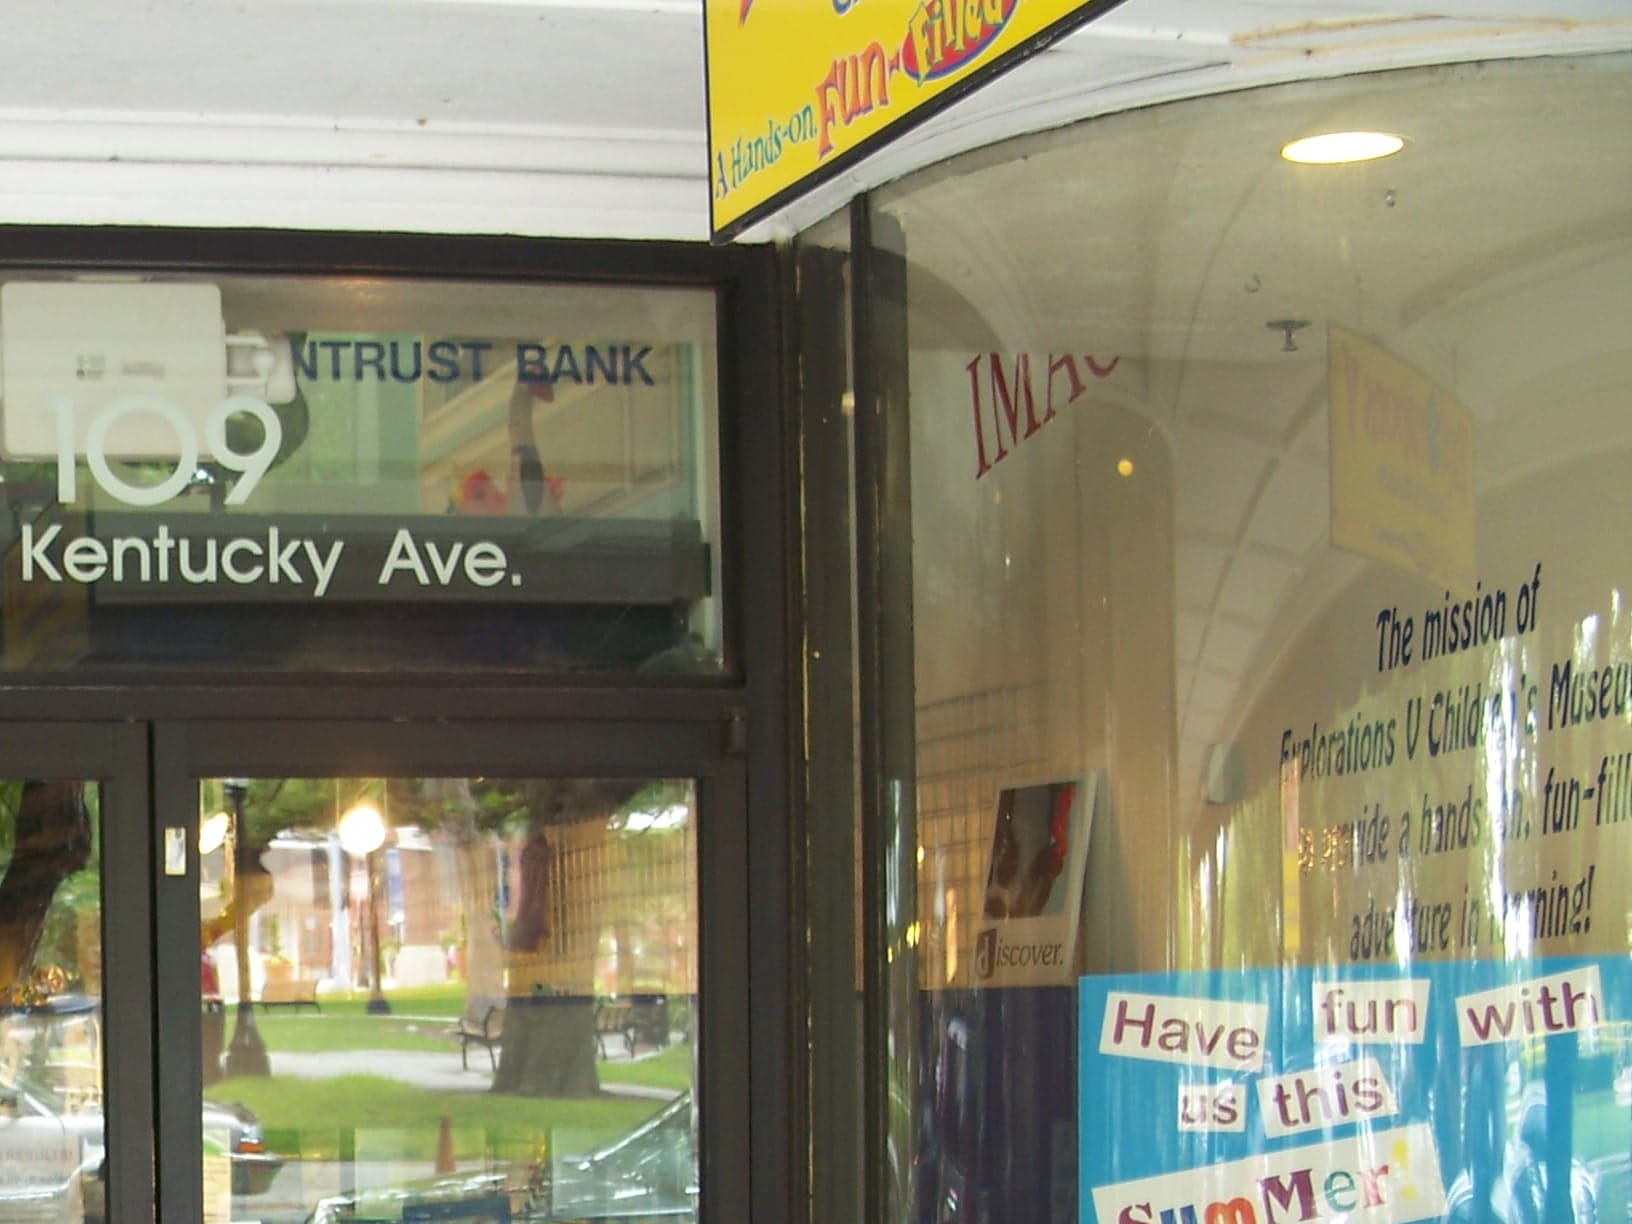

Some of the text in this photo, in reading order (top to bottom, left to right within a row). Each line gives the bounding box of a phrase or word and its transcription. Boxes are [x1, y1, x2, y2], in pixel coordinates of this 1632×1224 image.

[716, 152, 728, 199] A
[516, 345, 655, 387] BANK
[44, 395, 282, 505] 109
[21, 524, 344, 597] Kentucky
[379, 529, 522, 586] Ave.
[1377, 562, 1541, 672] The mission of
[1399, 811, 1409, 858] a
[1461, 885, 1479, 949] in
[1113, 982, 1599, 1060] Have fun with
[1181, 1072, 1383, 1127] us this
